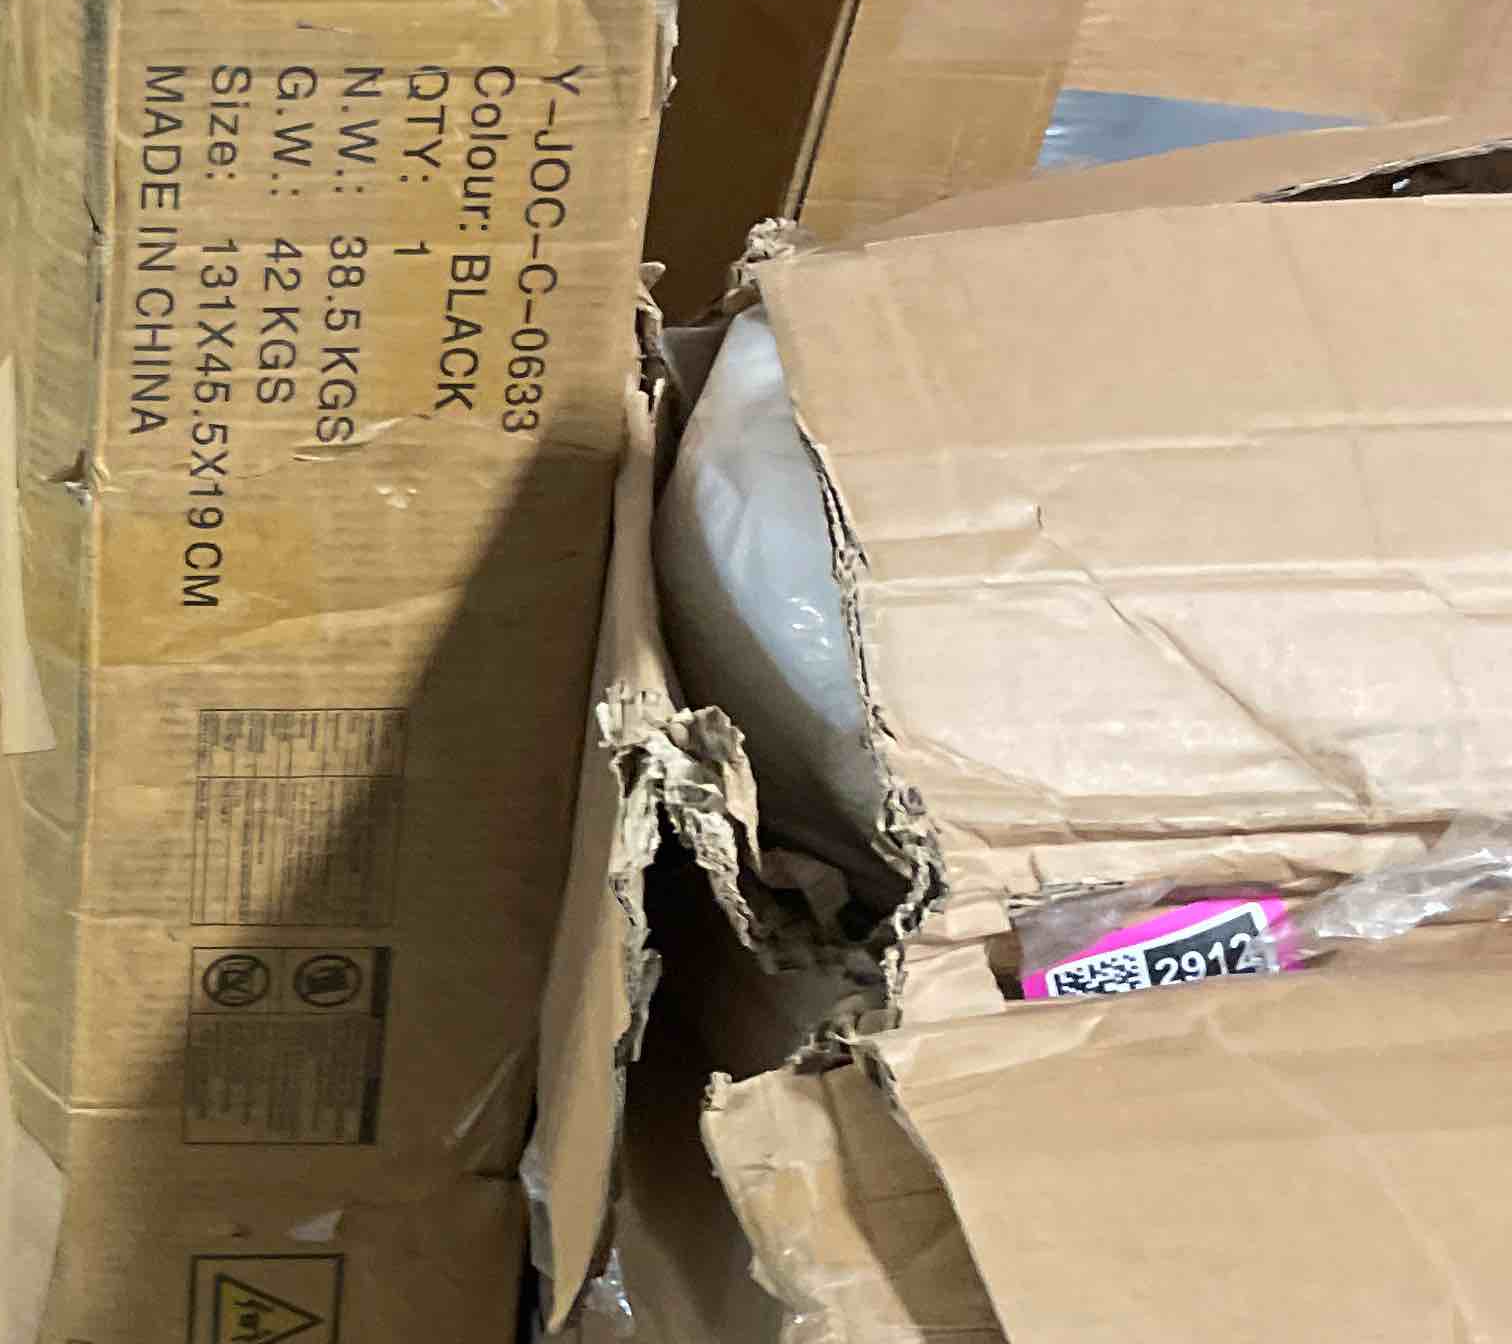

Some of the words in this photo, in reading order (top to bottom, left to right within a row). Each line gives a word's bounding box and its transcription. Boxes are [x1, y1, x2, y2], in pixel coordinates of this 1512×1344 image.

[140, 65, 186, 210] MADE
[205, 63, 252, 182] Size:
[270, 66, 318, 197] G.W.:
[335, 66, 385, 195] N.W.:
[399, 67, 450, 184] QTY:
[458, 66, 516, 233] Colour:
[134, 227, 176, 272] IN
[263, 238, 303, 291] 42
[324, 234, 368, 333] 38.5
[392, 240, 432, 257] 1
[501, 63, 583, 435] Y-JOC-C-0633
[129, 289, 175, 436] CHINA
[256, 305, 300, 406] KGS
[434, 253, 491, 412] BLACK
[314, 346, 360, 444] KGS
[1154, 932, 1254, 985] 2912
